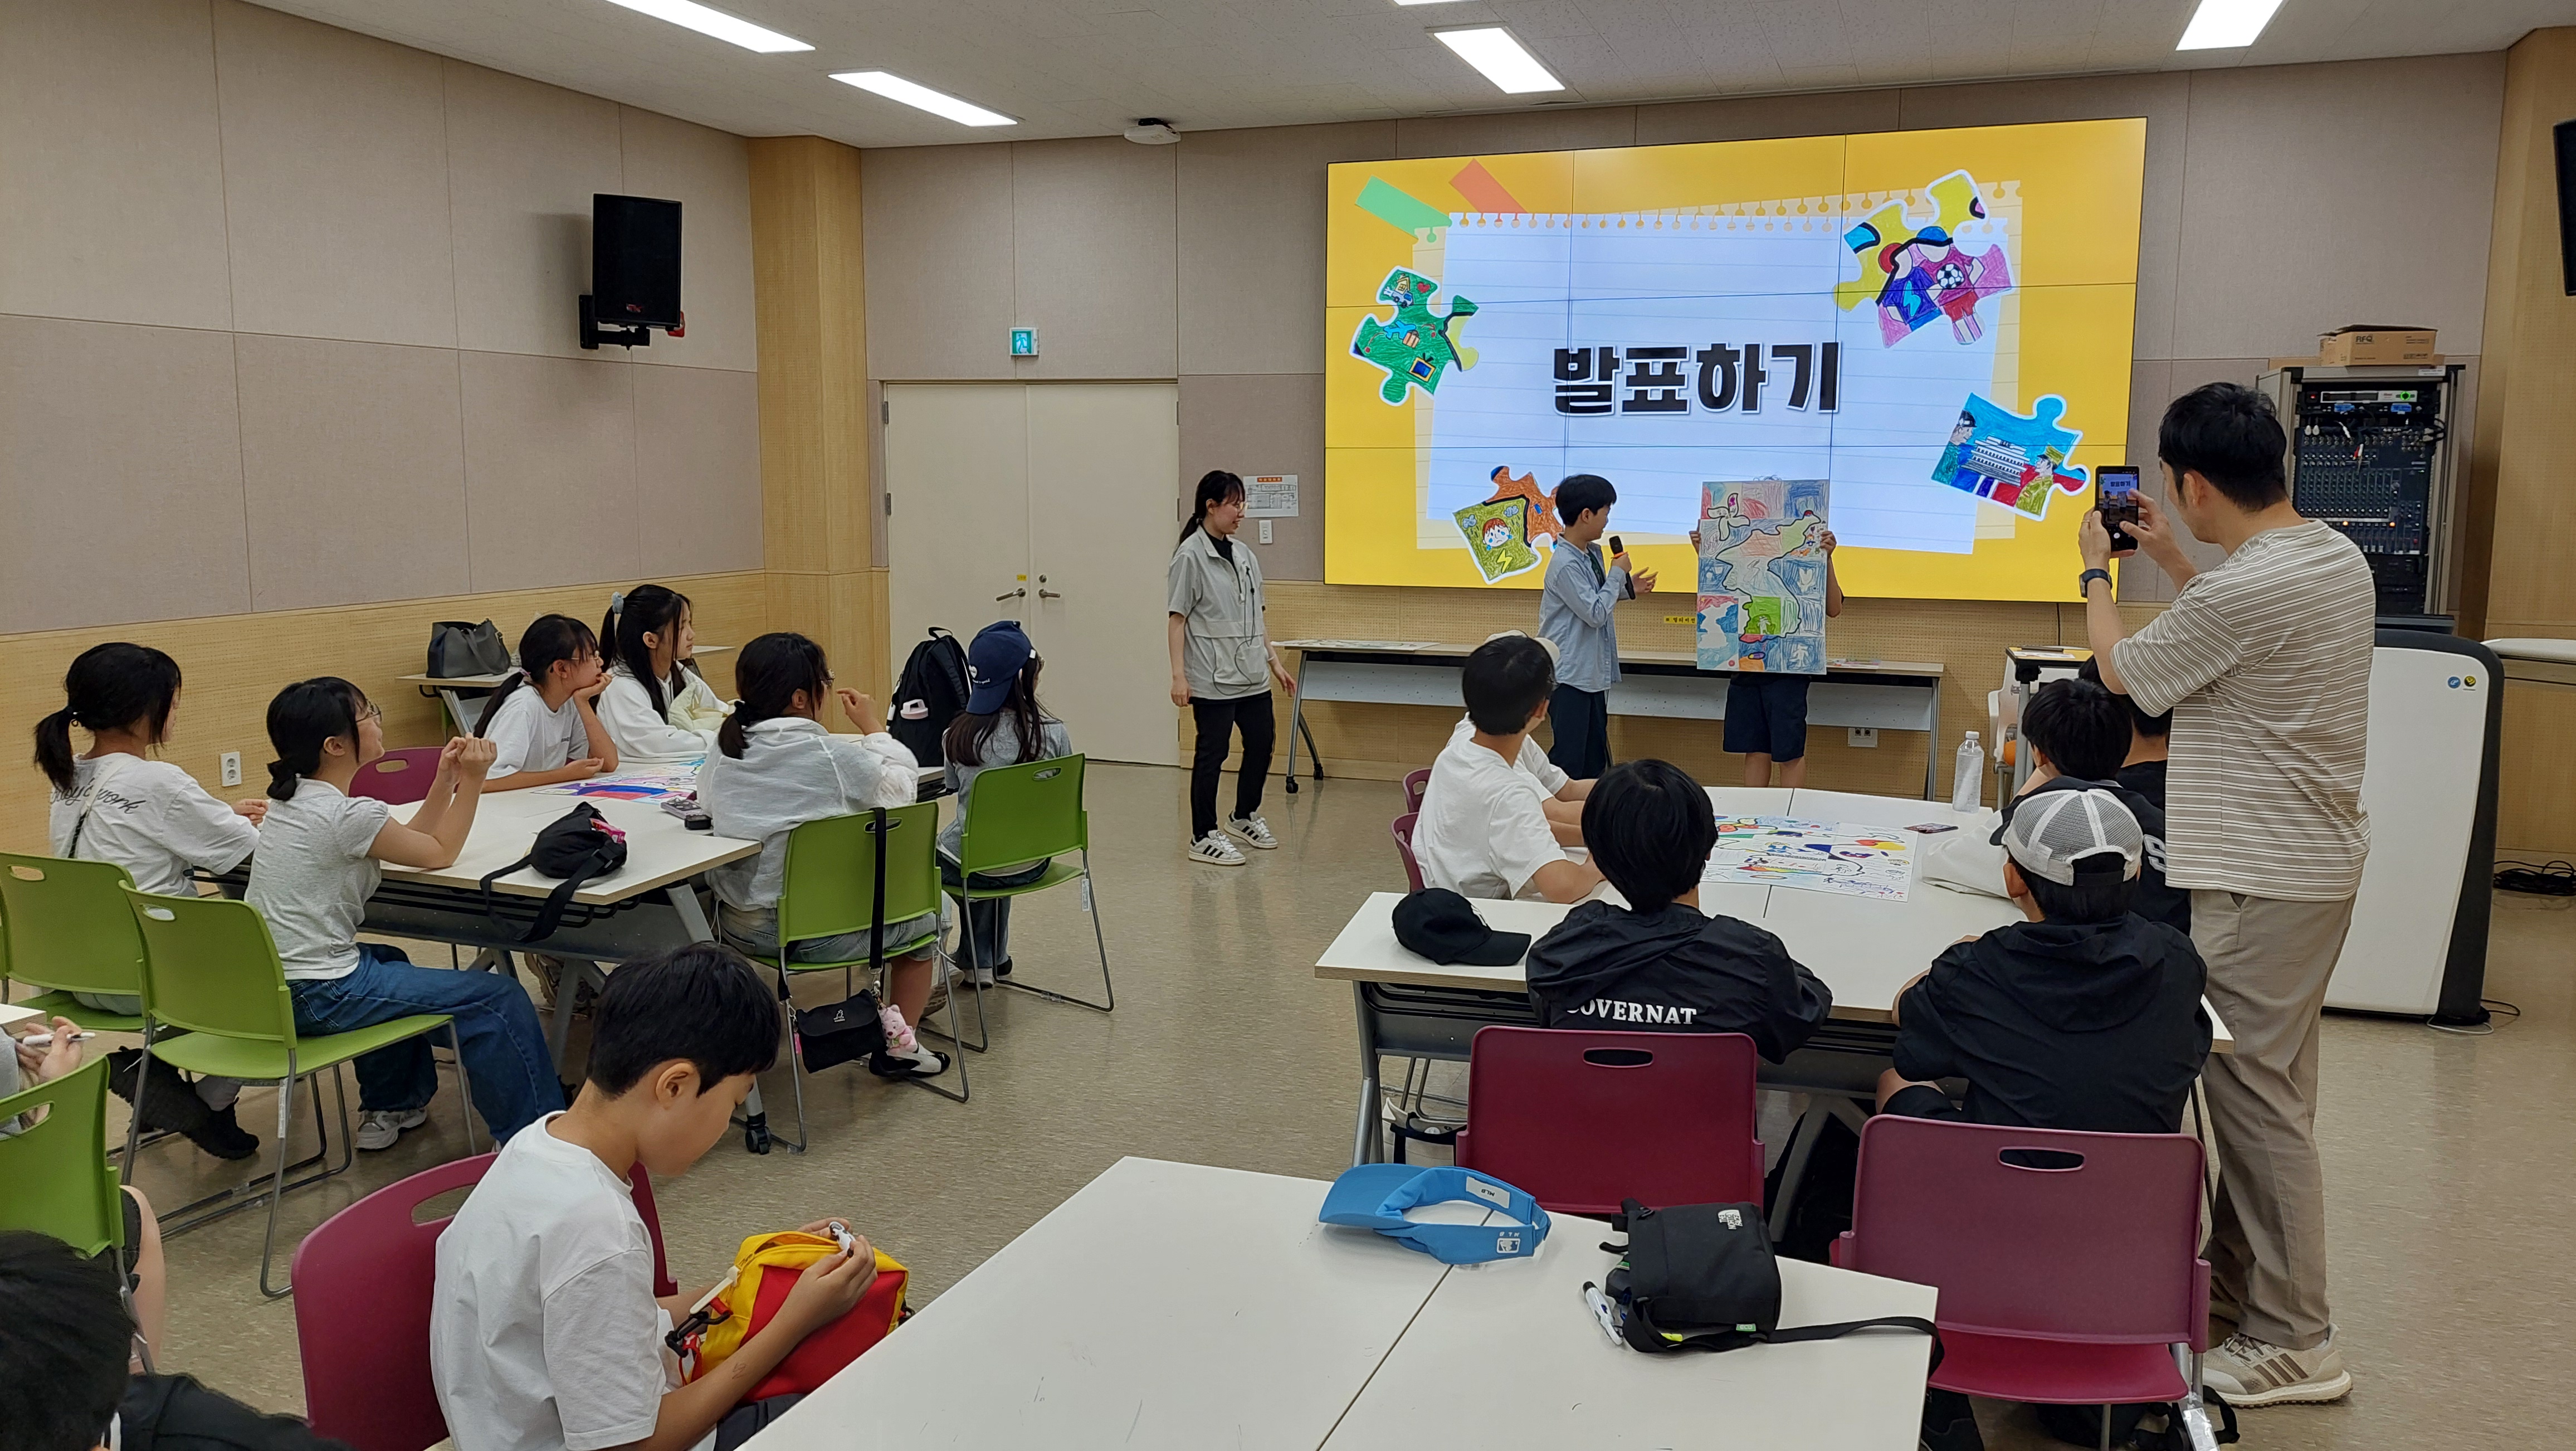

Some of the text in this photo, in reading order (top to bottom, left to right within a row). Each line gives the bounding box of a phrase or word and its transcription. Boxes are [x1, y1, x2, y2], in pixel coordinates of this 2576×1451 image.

[1553, 342, 1840, 414] 발표하기
[1567, 999, 1697, 1025] OVERNAT
[1481, 1188, 1495, 1197] MLB
[1718, 1214, 1727, 1223] THE
